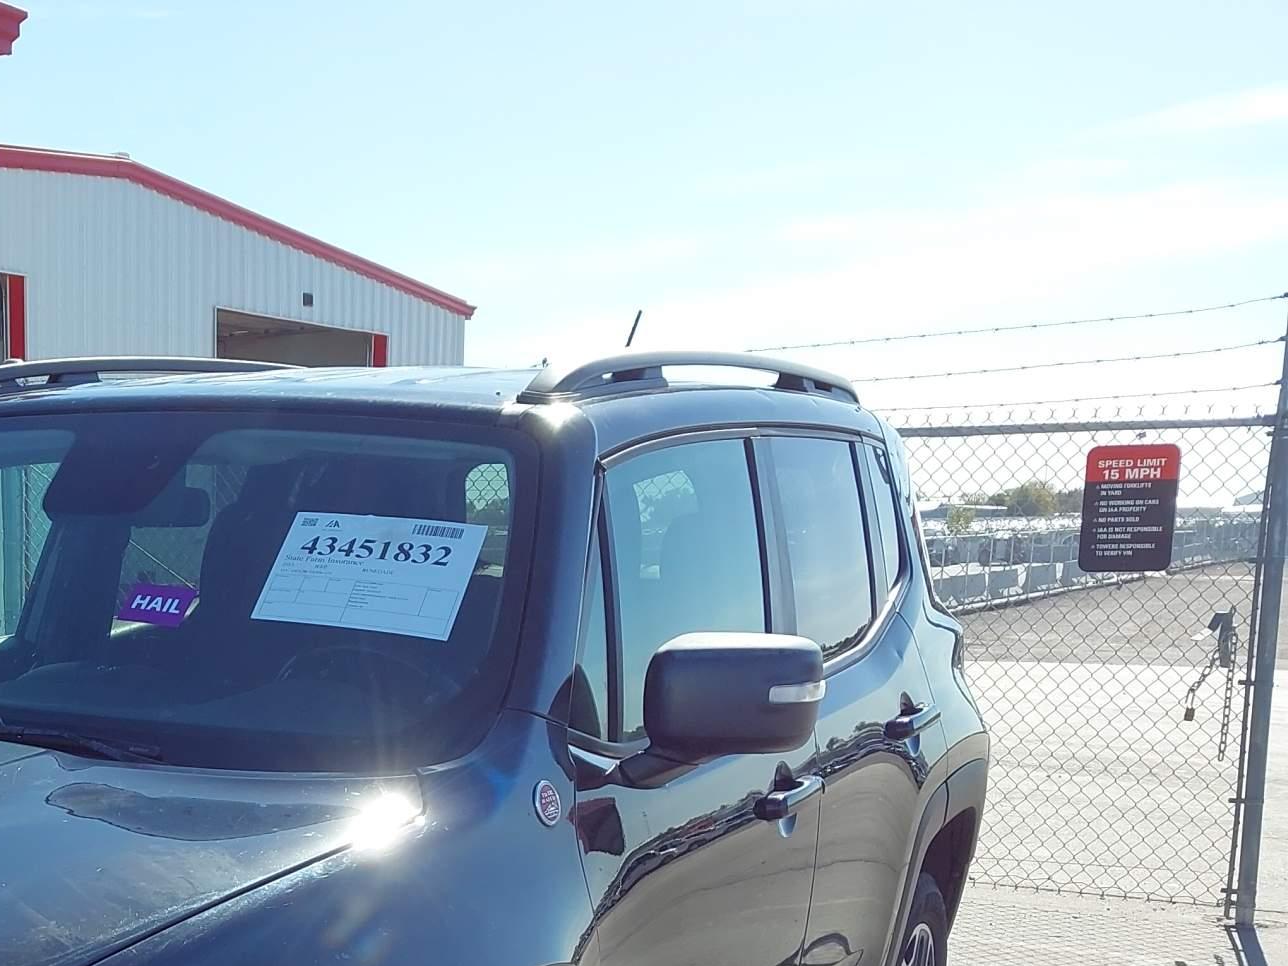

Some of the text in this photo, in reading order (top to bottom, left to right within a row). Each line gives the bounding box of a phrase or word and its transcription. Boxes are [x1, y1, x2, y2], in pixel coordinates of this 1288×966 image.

[1098, 458, 1167, 468] SPEED LIMIT
[1103, 467, 1161, 480] 15 MPH
[300, 535, 453, 567] 43451832
[285, 554, 303, 562] State
[131, 594, 180, 614] HAIL
